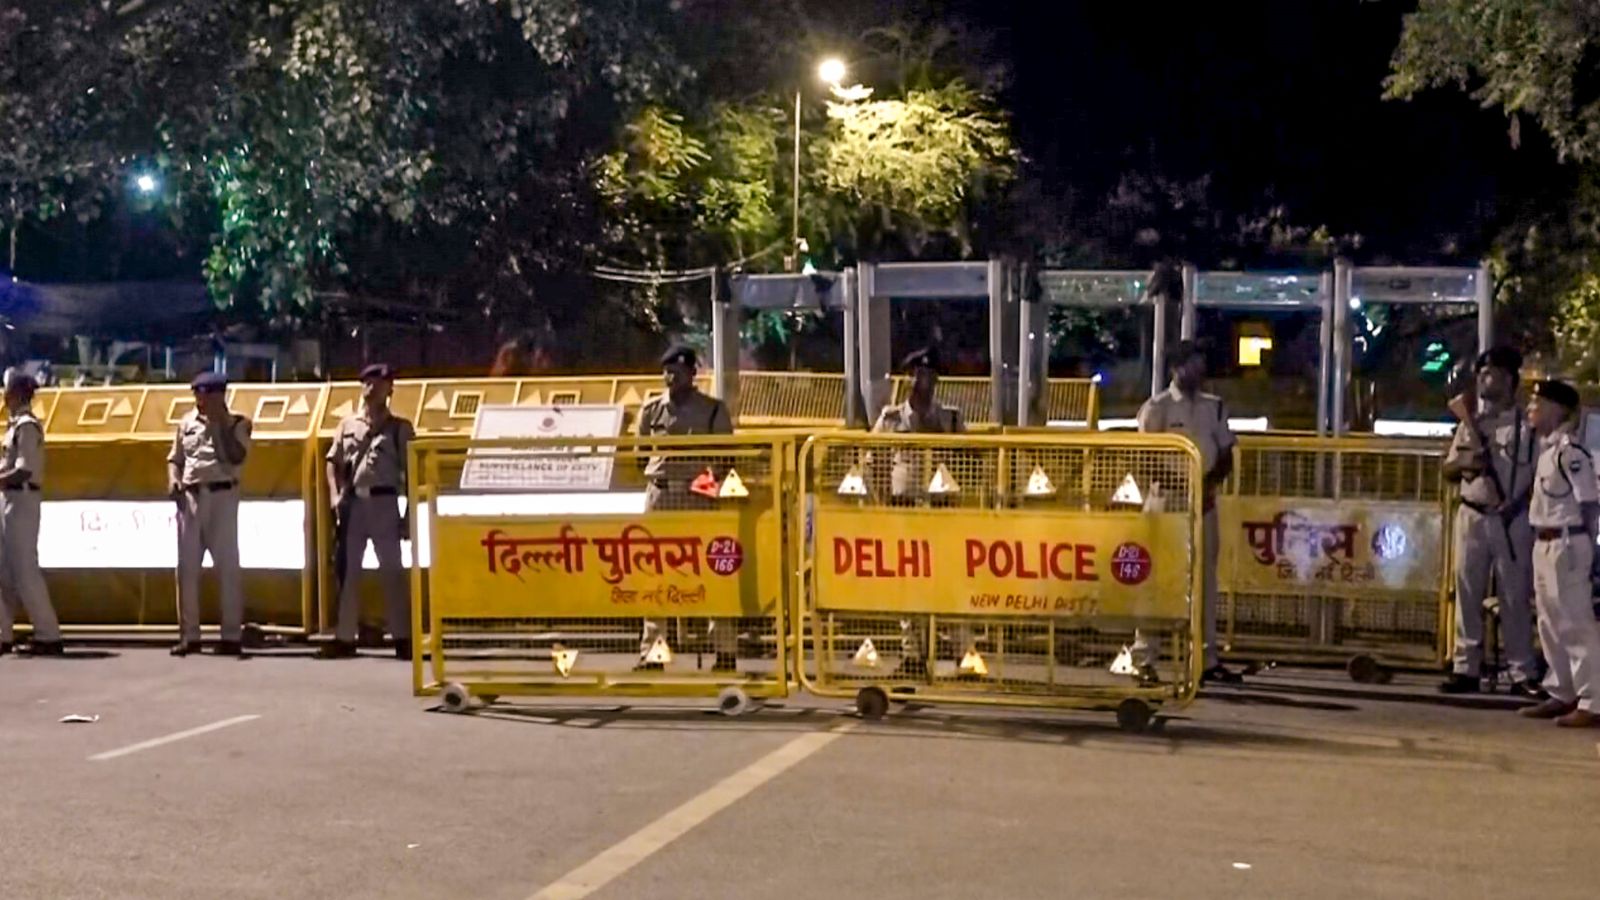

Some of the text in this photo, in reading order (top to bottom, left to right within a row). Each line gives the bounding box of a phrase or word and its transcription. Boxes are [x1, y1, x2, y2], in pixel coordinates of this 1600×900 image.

[481, 522, 703, 585] दिल्ली पुलिस
[832, 537, 1100, 582] DELHI POLICE
[969, 593, 1001, 609] NEW
[1005, 594, 1048, 610] DELHI
